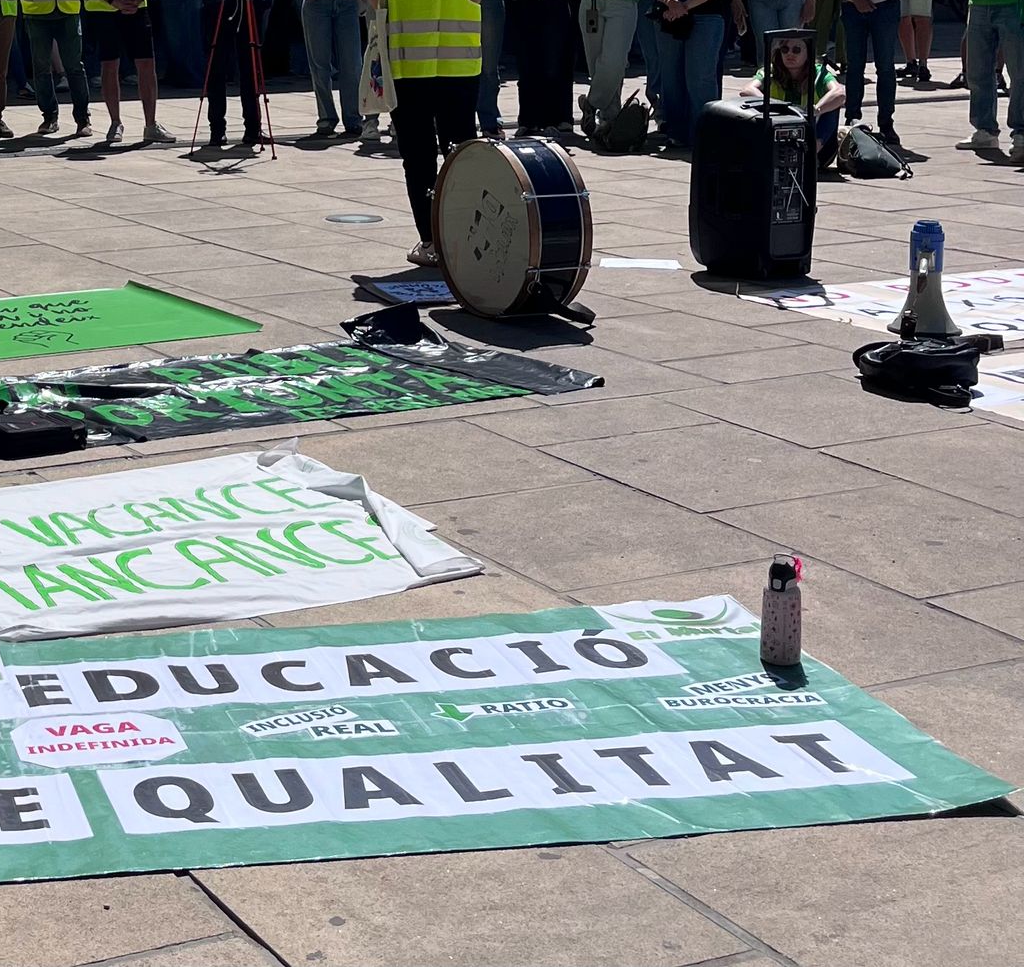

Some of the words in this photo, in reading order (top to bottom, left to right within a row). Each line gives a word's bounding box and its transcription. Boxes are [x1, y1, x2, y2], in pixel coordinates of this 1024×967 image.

[28, 298, 90, 311] que
[15, 629, 649, 708] EDUCACIÓ
[688, 672, 781, 696] MENYS
[480, 698, 570, 715] RATIO
[665, 693, 823, 708] BUROCRACIA
[245, 704, 347, 733] INCLUSIÓ
[44, 720, 141, 737] VAGA
[313, 720, 397, 737] REAL
[26, 735, 176, 755] INDEFINIDA
[132, 733, 856, 823] QUALITAT
